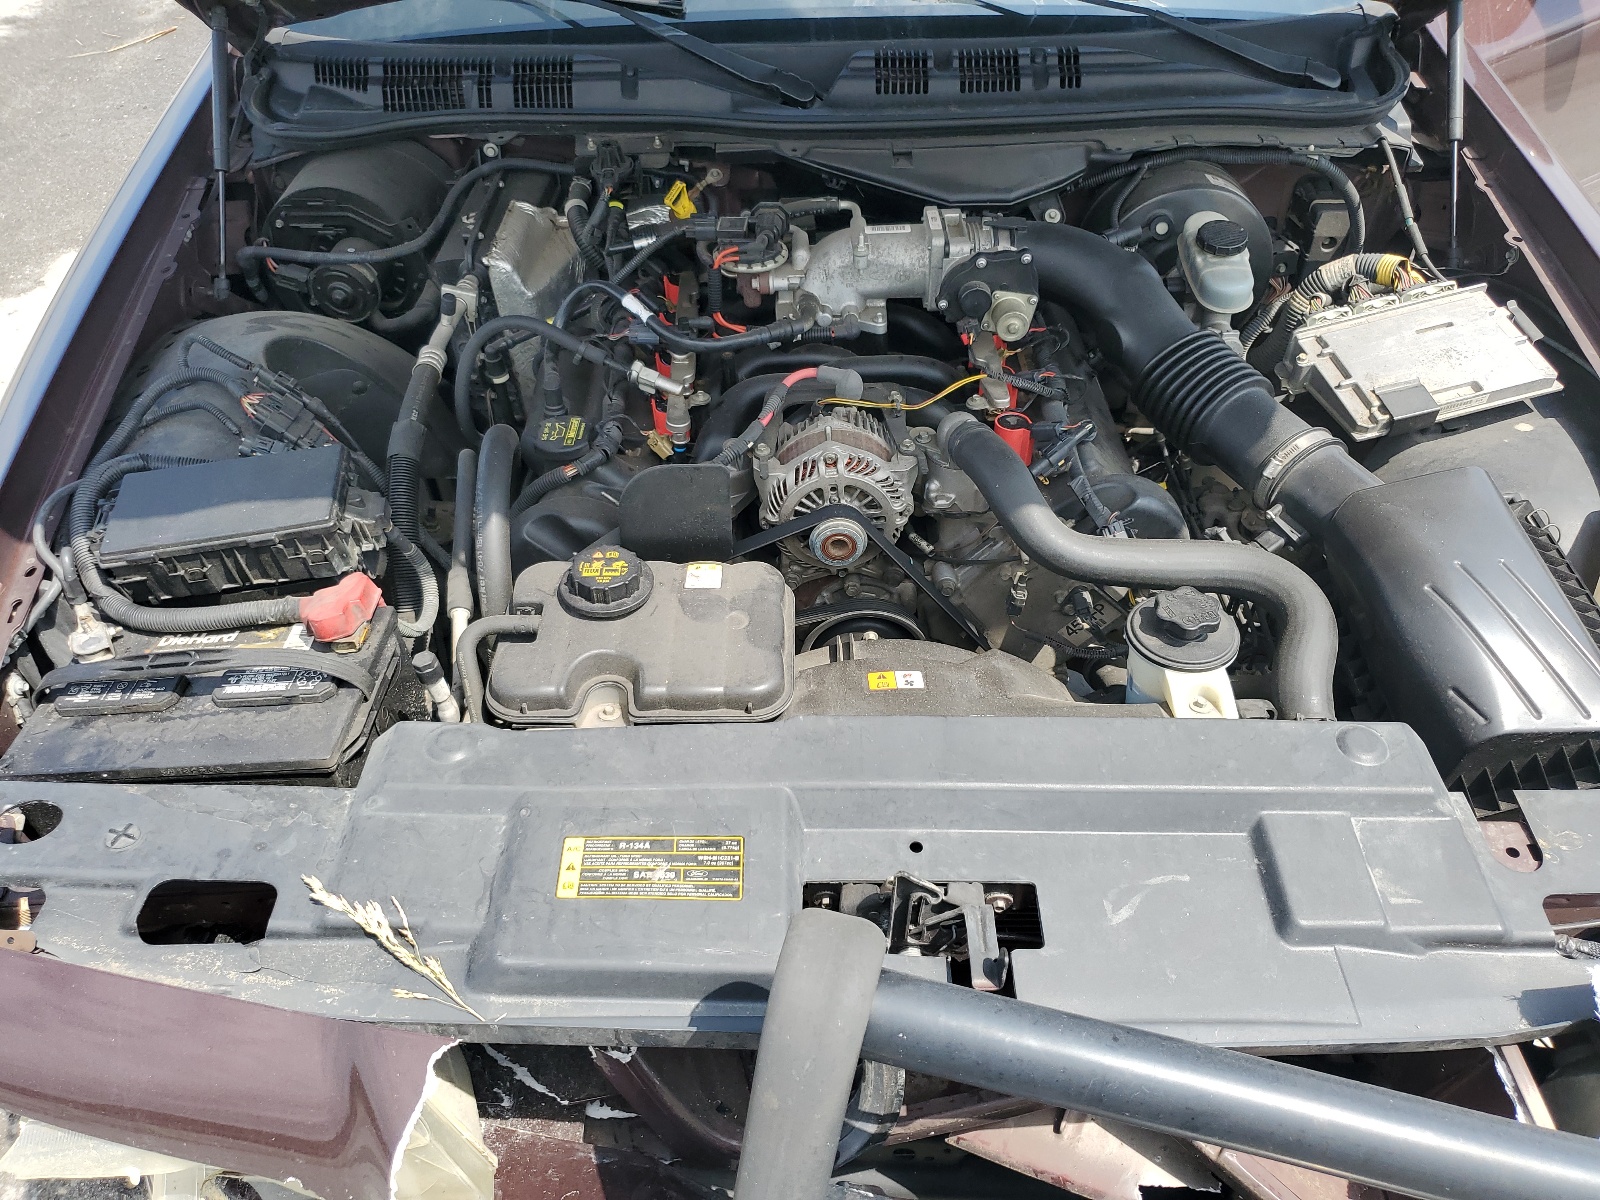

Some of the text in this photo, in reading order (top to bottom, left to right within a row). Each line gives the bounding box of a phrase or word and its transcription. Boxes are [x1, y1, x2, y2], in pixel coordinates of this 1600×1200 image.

[157, 631, 240, 647] DieHard
[566, 845, 581, 853] A/C
[618, 841, 651, 850] R-134A
